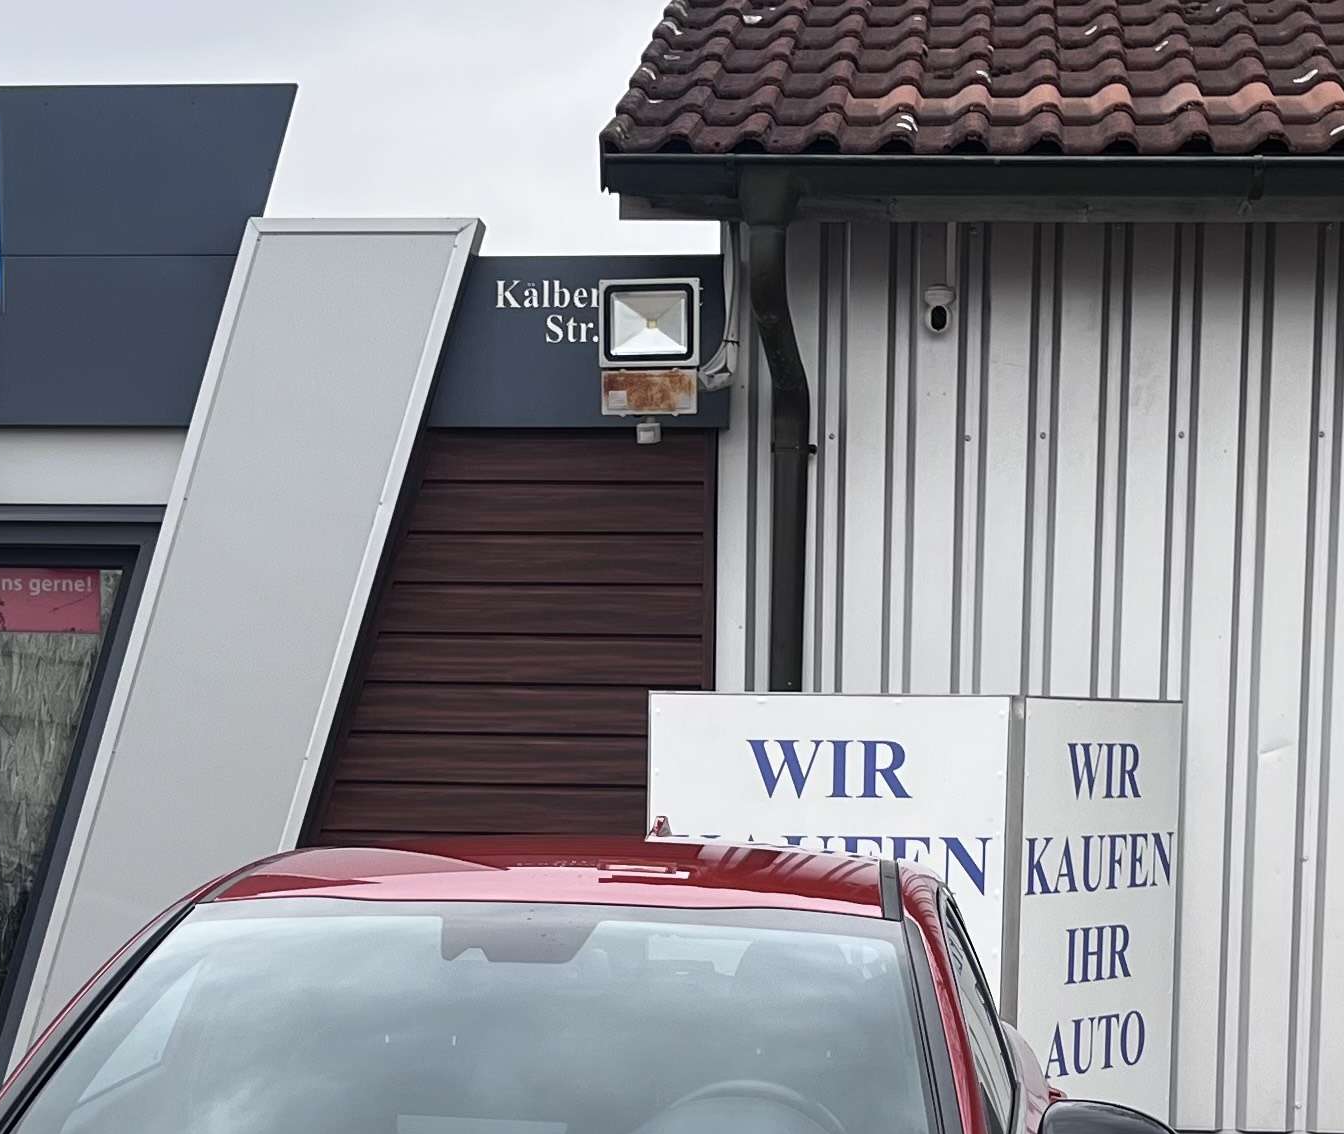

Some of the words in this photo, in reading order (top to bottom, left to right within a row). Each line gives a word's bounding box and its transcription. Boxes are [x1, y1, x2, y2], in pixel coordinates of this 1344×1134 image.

[546, 315, 599, 343] Str.
[28, 577, 92, 597] gerne!
[746, 739, 912, 799] WIR
[1067, 742, 1141, 800] WIR
[1024, 831, 1174, 897] KAUFEN
[1064, 923, 1132, 985] IHR
[1045, 1010, 1145, 1079] AUTO
